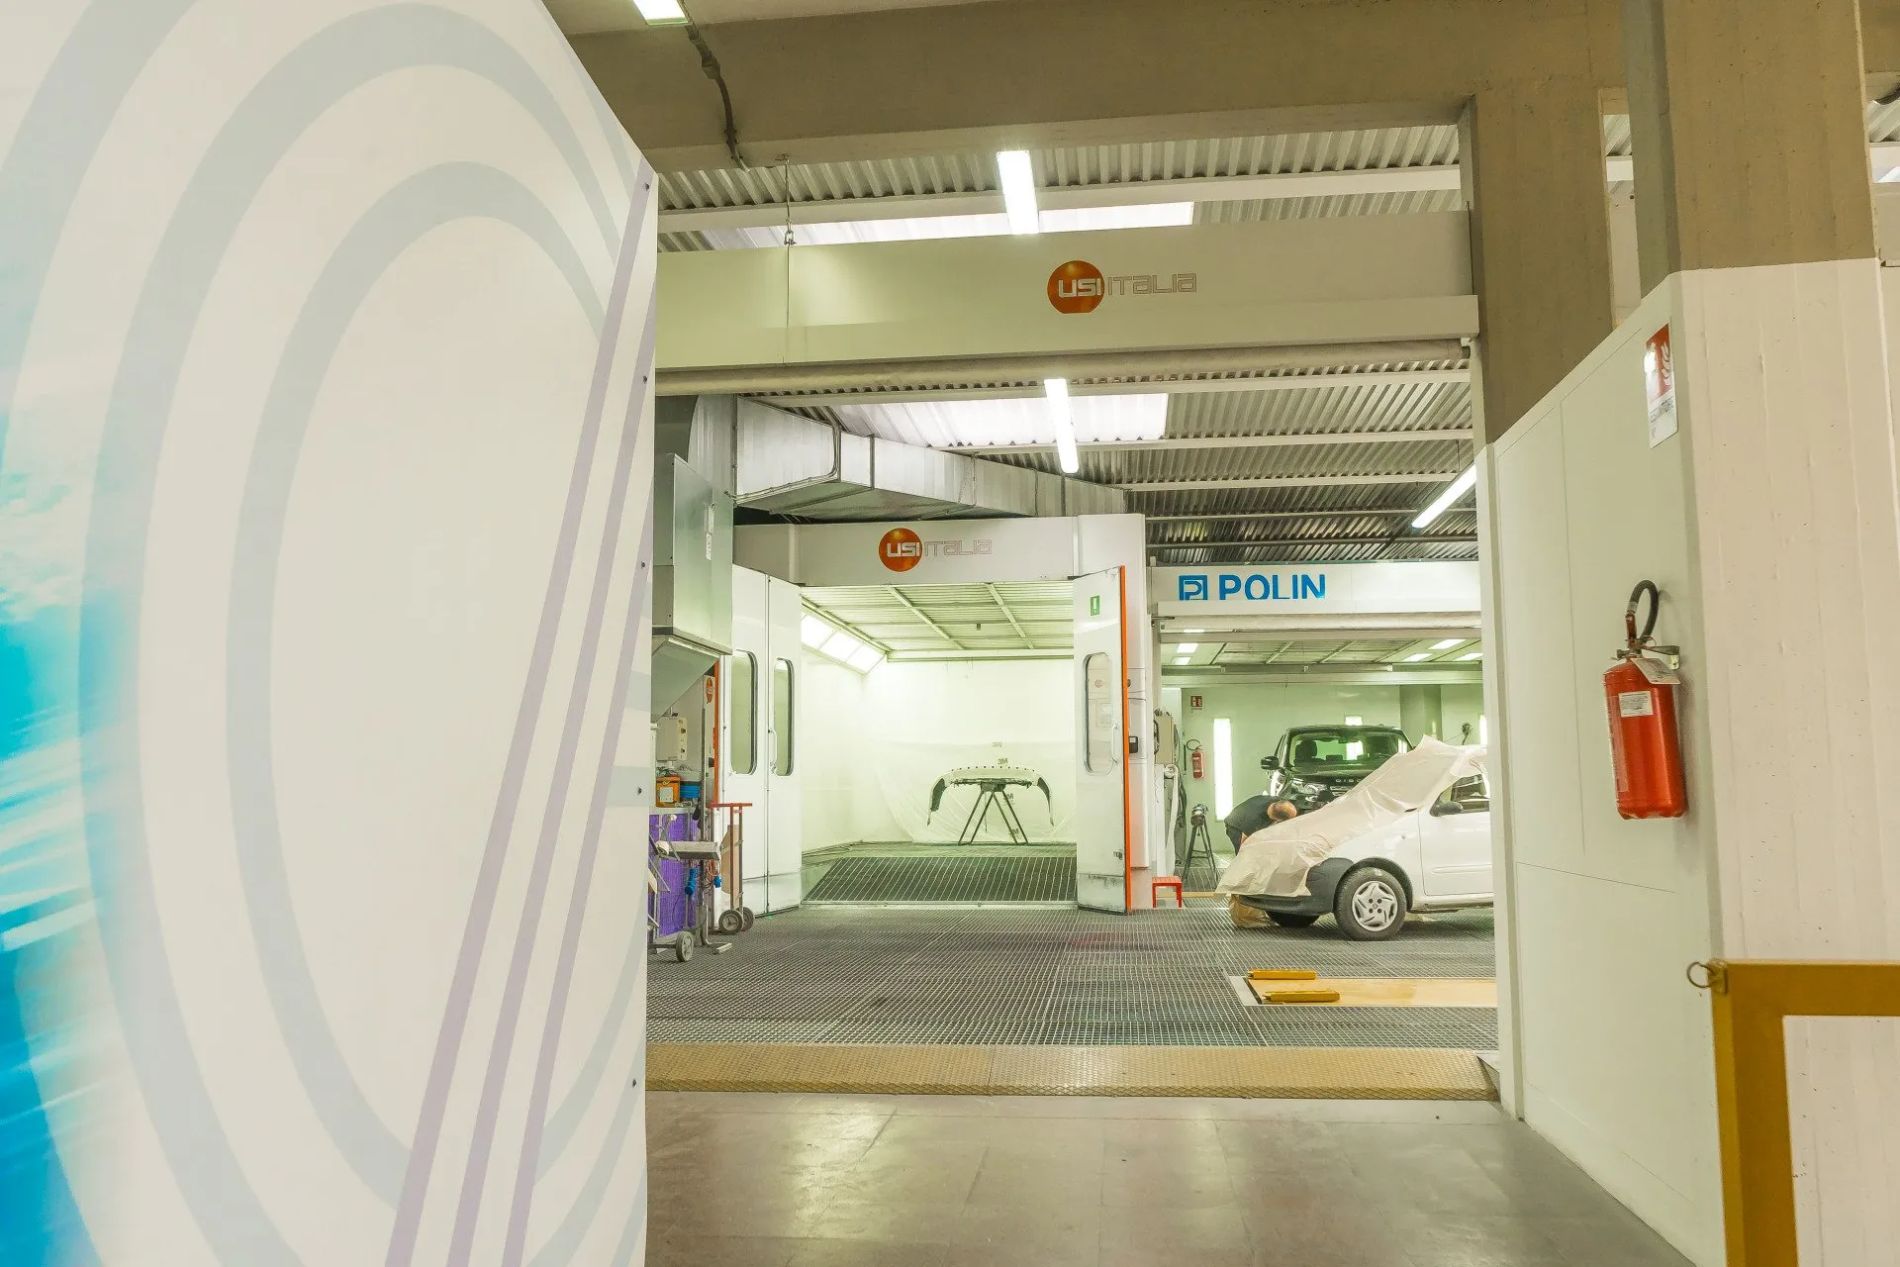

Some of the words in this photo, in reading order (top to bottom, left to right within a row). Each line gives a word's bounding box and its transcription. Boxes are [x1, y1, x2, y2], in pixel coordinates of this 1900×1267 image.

[1058, 278, 1103, 299] USI
[886, 541, 921, 558] USI
[1219, 574, 1326, 600] POLIN
